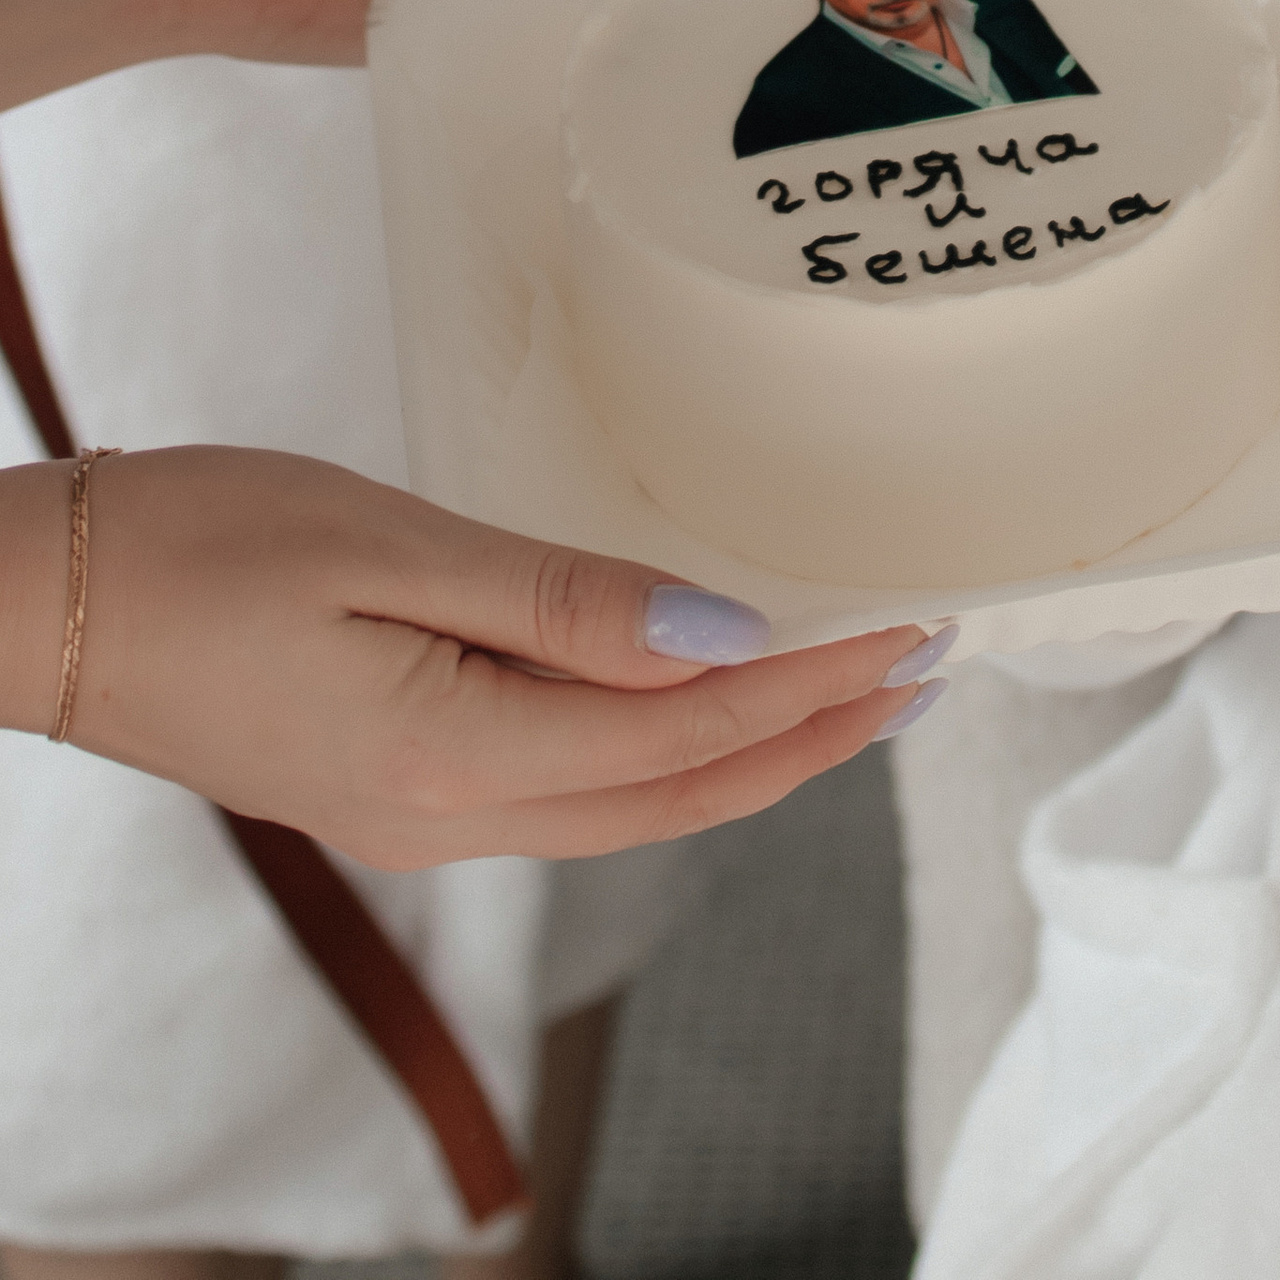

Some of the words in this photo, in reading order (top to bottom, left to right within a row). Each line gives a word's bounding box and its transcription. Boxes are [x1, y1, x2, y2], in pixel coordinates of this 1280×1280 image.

[755, 132, 1100, 215] горяча
[924, 192, 987, 229] и
[800, 192, 1172, 285] бешена
